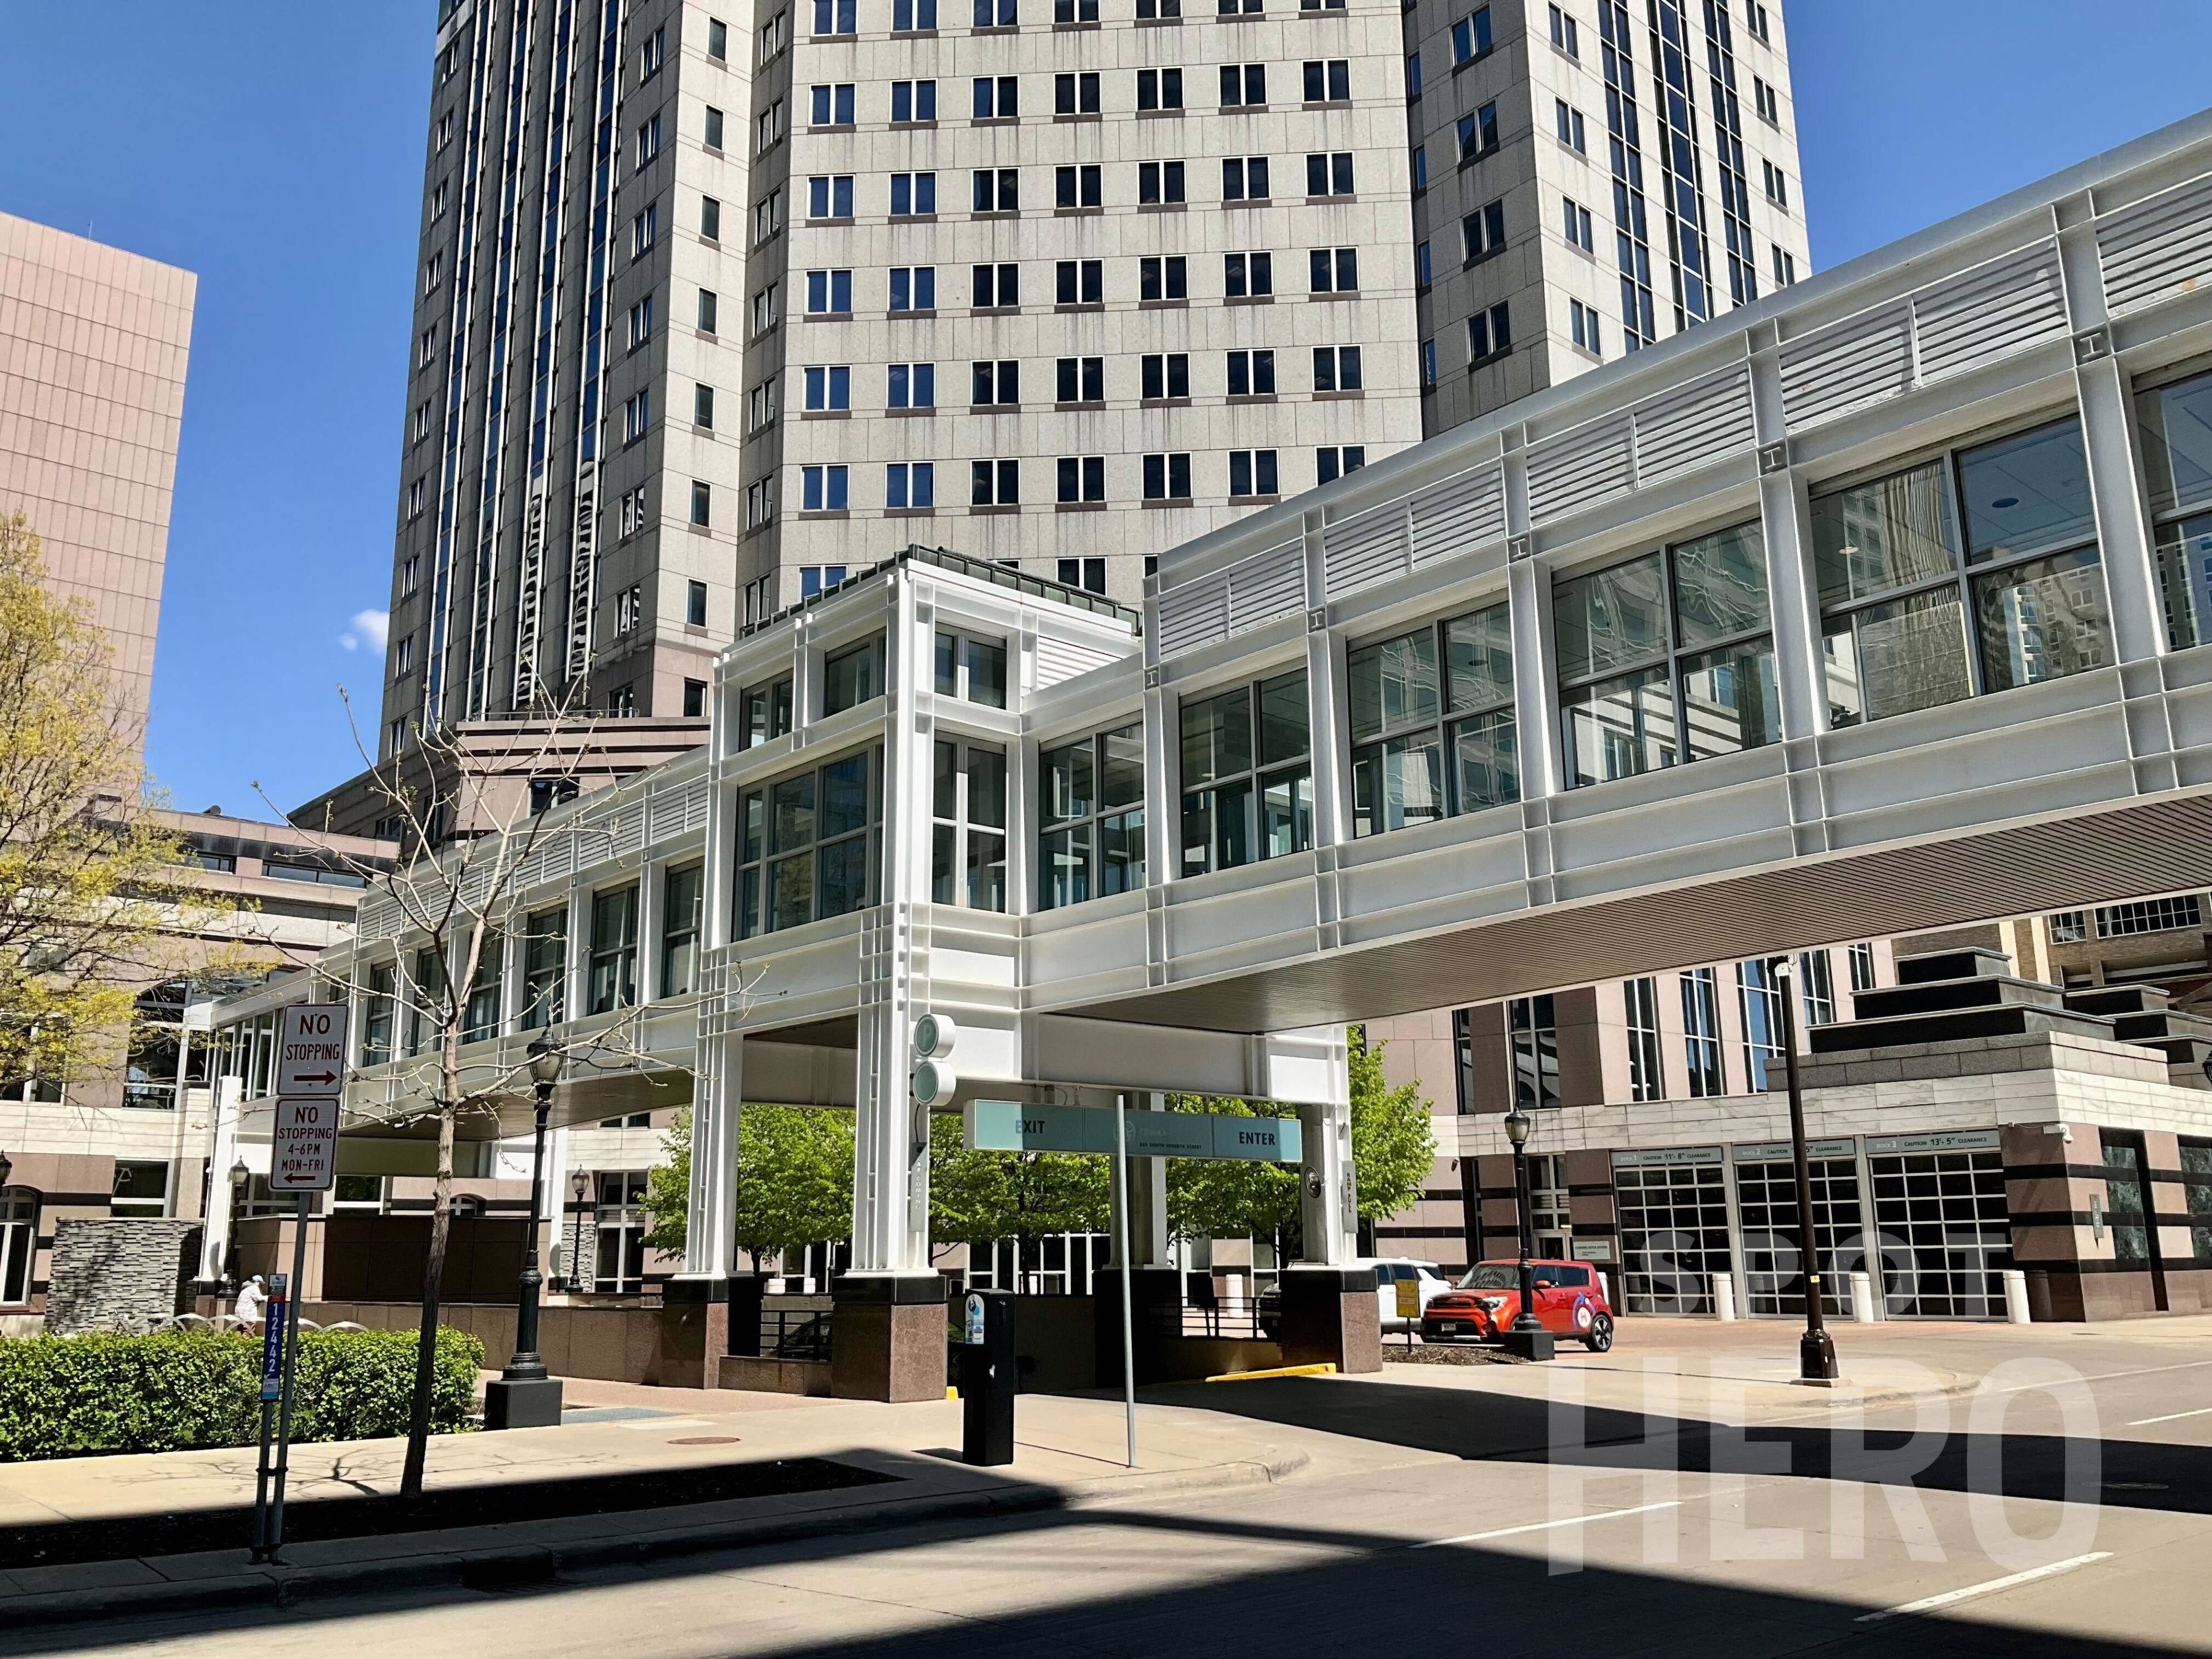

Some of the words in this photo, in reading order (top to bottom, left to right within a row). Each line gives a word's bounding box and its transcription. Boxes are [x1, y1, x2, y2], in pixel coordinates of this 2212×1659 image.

[299, 1014, 331, 1035] NO
[285, 1043, 340, 1060] STOPPING
[295, 1107, 318, 1124] NO
[278, 1127, 332, 1139] STOPPING
[1016, 1120, 1046, 1134] EXIT
[1239, 1131, 1275, 1146] ENTER
[287, 1143, 320, 1155] 4-6PM
[281, 1159, 324, 1171] MON-FRI
[970, 1300, 975, 1310] P
[1581, 1310, 1588, 1323] H
[268, 1303, 279, 1372] 12442
